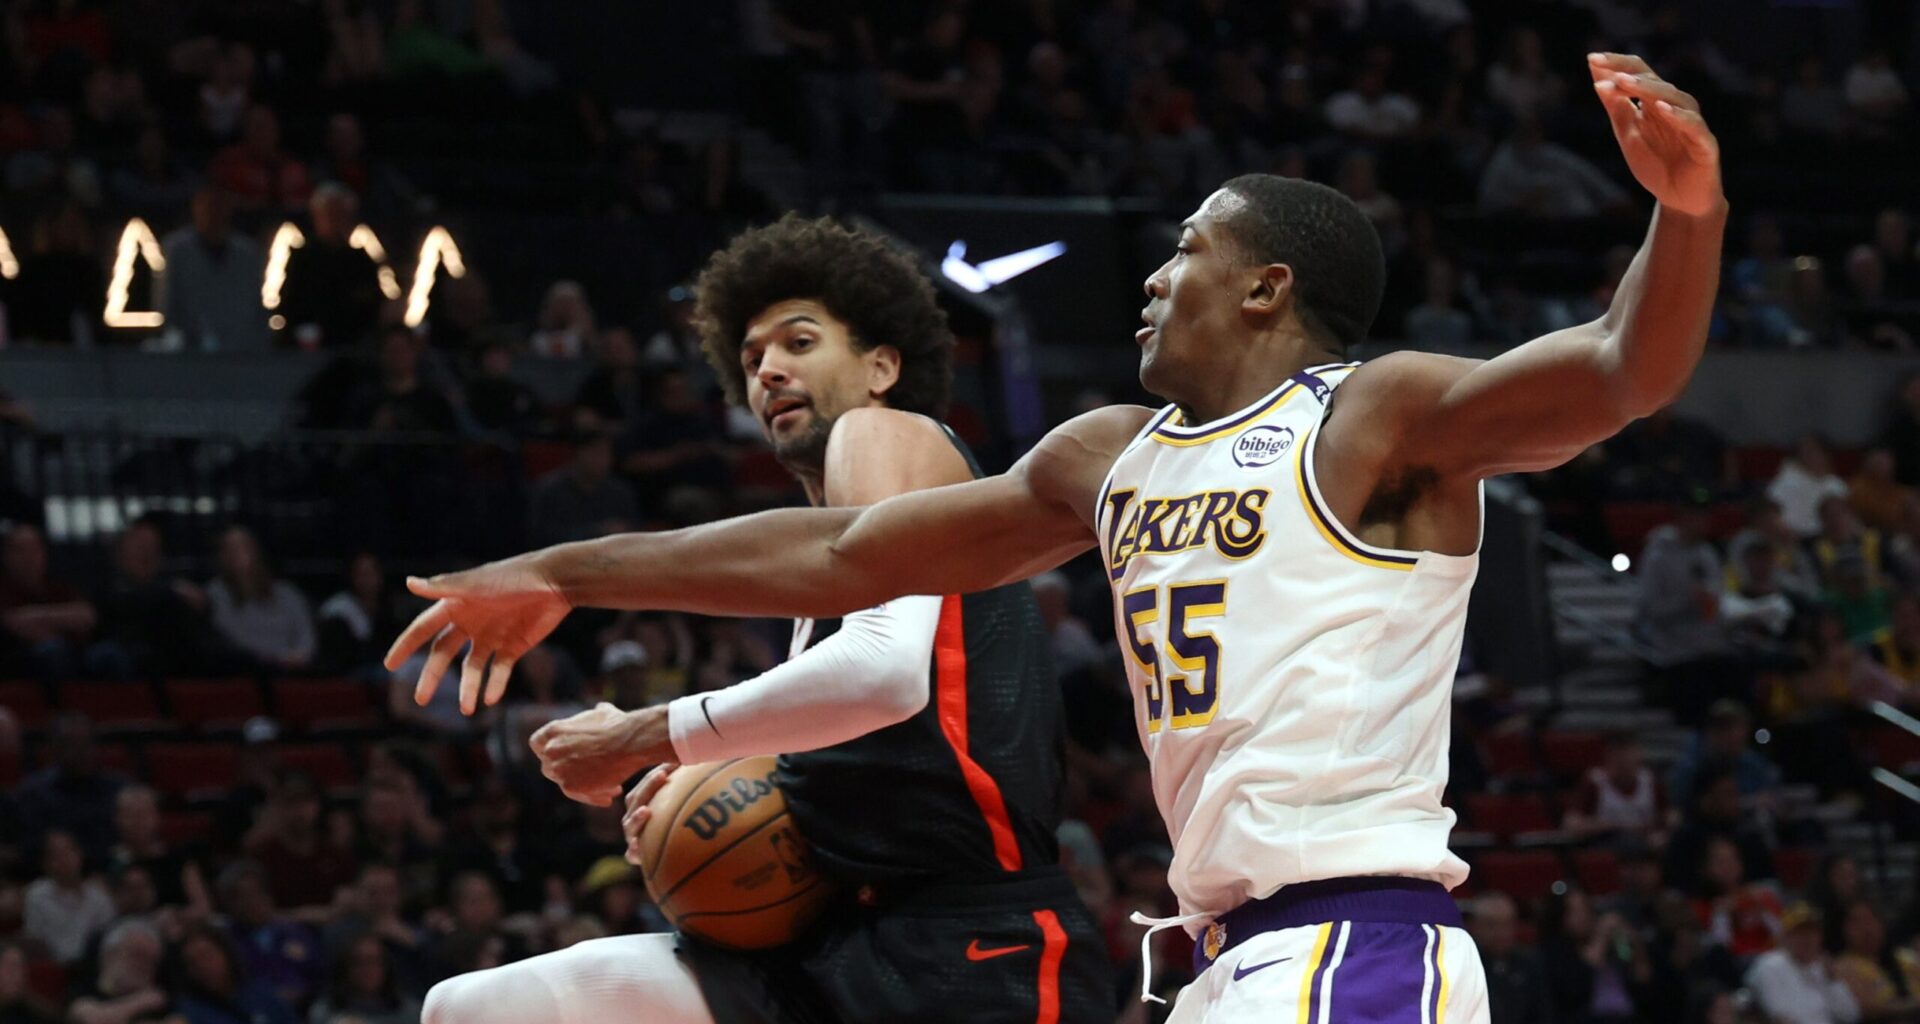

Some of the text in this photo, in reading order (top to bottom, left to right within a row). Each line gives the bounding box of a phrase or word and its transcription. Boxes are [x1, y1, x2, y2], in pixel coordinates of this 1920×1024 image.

[1239, 436, 1290, 455] bibigo
[1107, 487, 1272, 584] LAKERS
[1122, 577, 1229, 734] 55
[683, 770, 781, 840] Wilso
